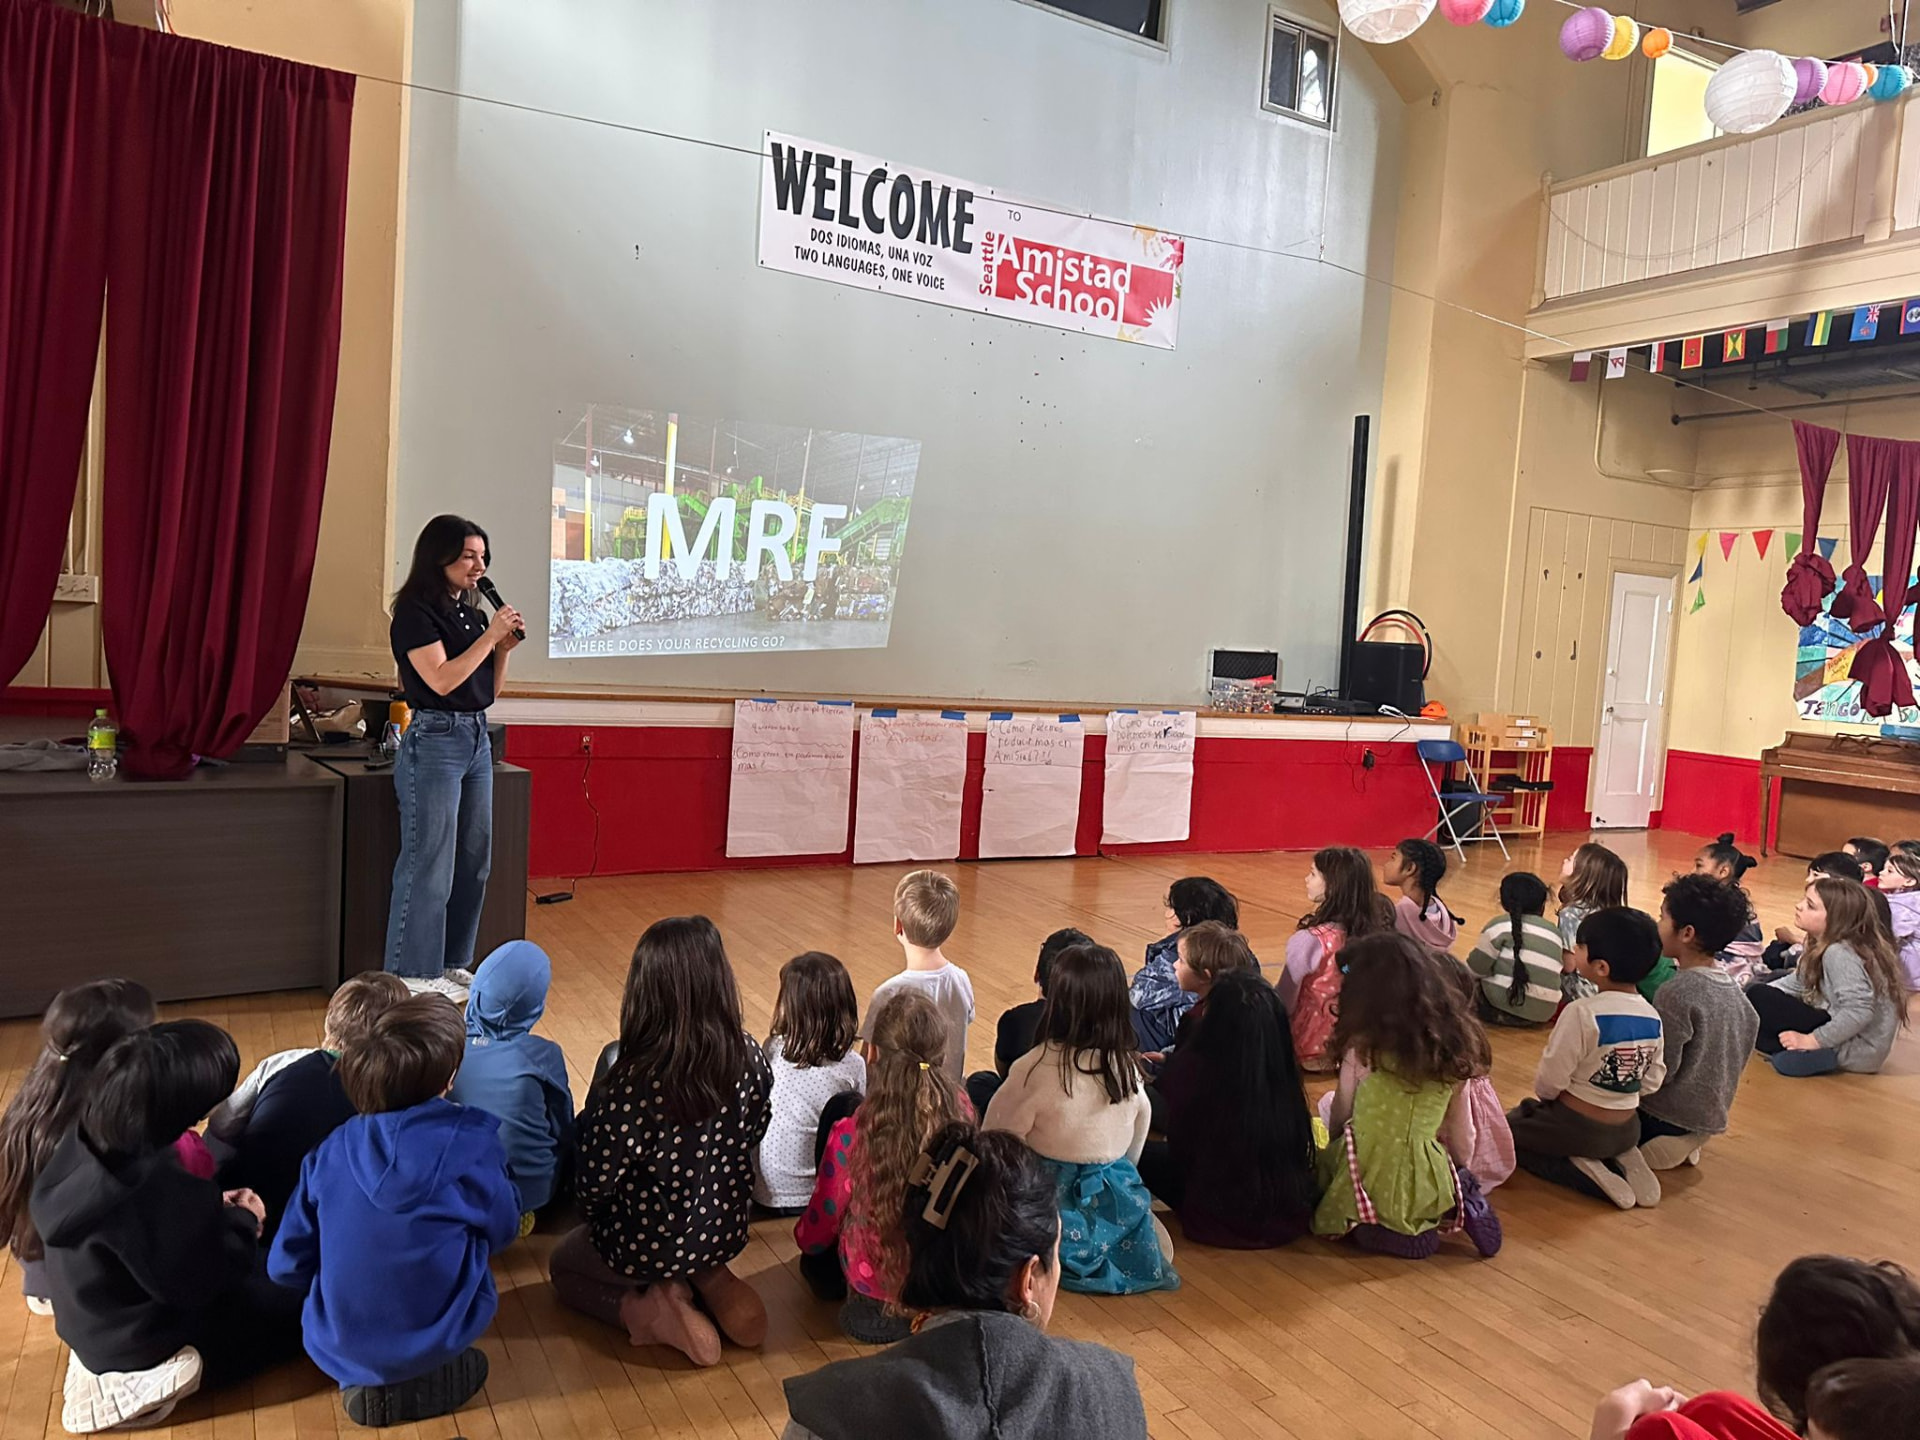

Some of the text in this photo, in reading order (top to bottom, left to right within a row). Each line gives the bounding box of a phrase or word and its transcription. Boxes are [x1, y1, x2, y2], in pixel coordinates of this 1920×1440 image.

[771, 142, 974, 254] WELCOME
[1008, 210, 1021, 222] TO
[795, 246, 945, 290] TWO LANGUAGES, ONE VOICE
[810, 228, 933, 268] DOS IDIOMAS, UNA VOZ
[979, 231, 995, 296] Seattle
[998, 235, 1131, 294] Amistad
[1015, 272, 1125, 323] School
[644, 492, 847, 582] MRF
[564, 635, 785, 652] WHERE DOES YOUR RECYCLING GO?
